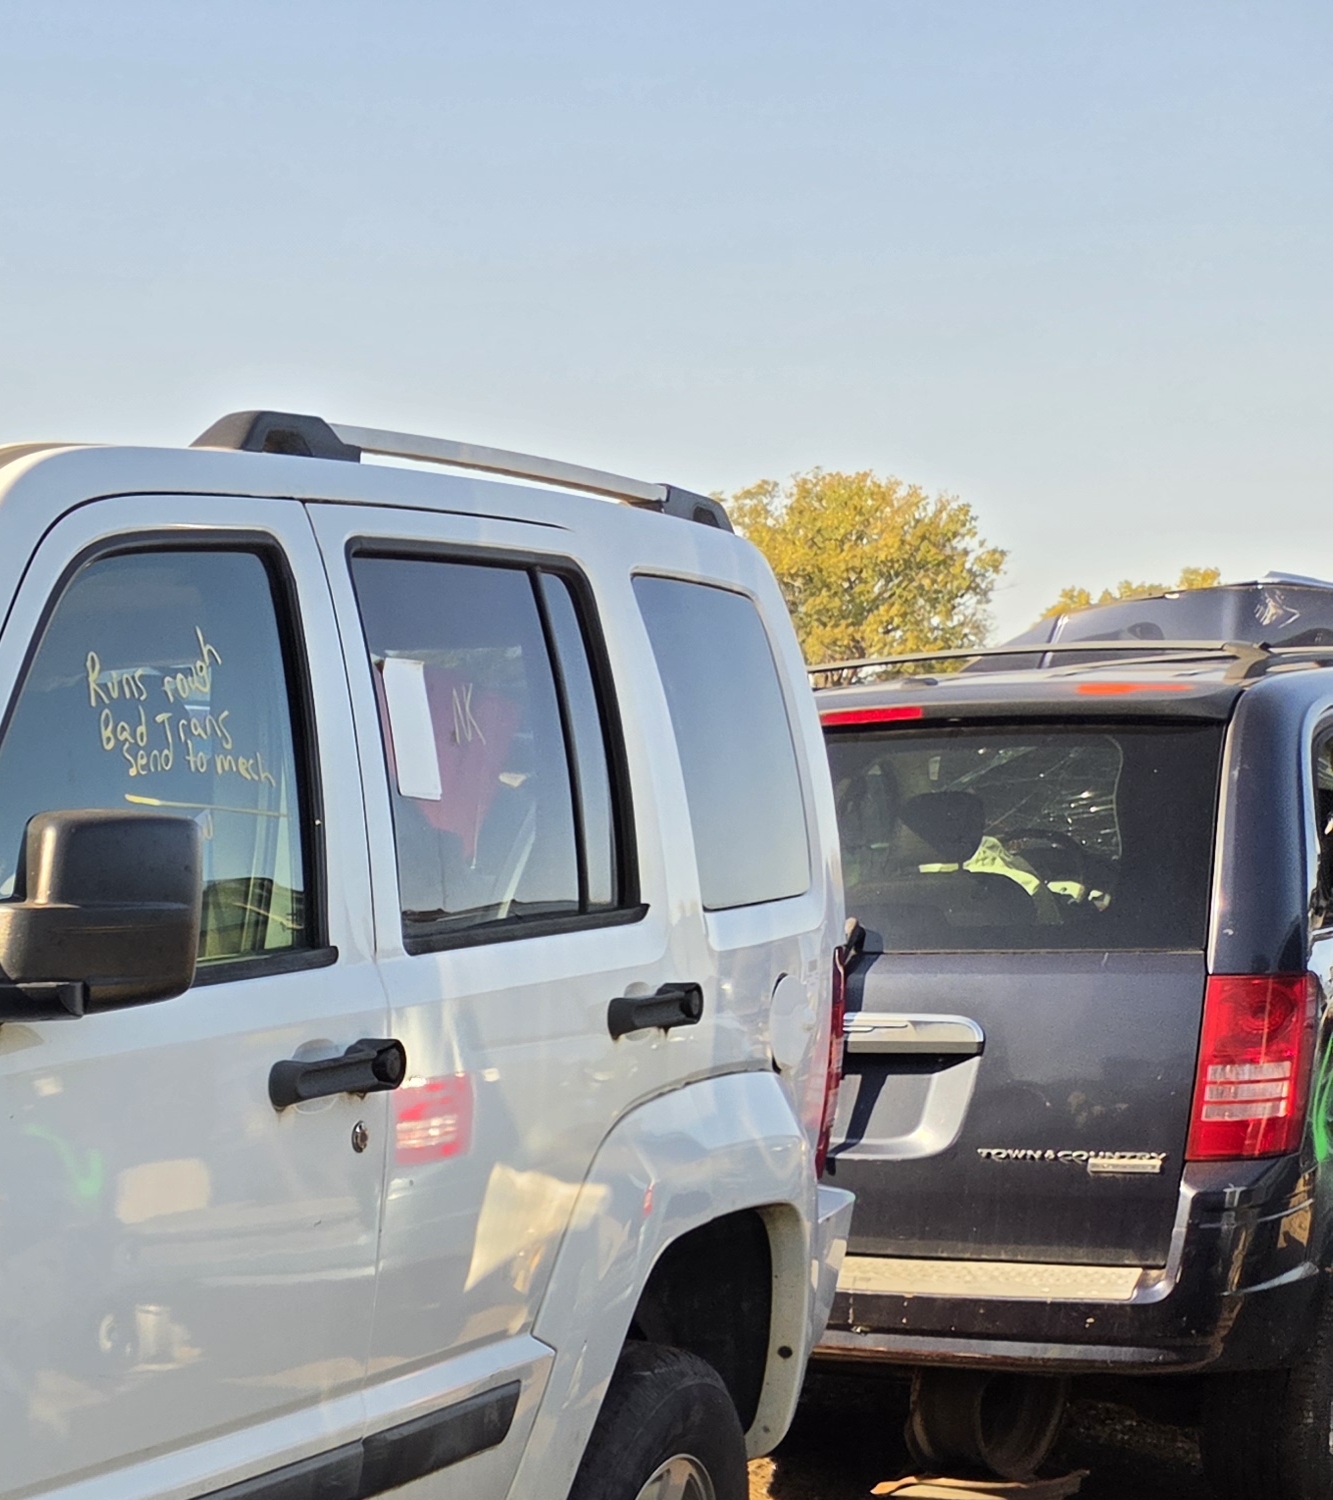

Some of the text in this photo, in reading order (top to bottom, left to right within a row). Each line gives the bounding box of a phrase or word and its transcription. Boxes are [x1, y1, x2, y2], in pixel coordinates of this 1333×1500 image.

[86, 625, 222, 707] Runs rough
[100, 705, 233, 751] Bad Trans
[186, 739, 208, 774] to
[214, 752, 276, 788] mech
